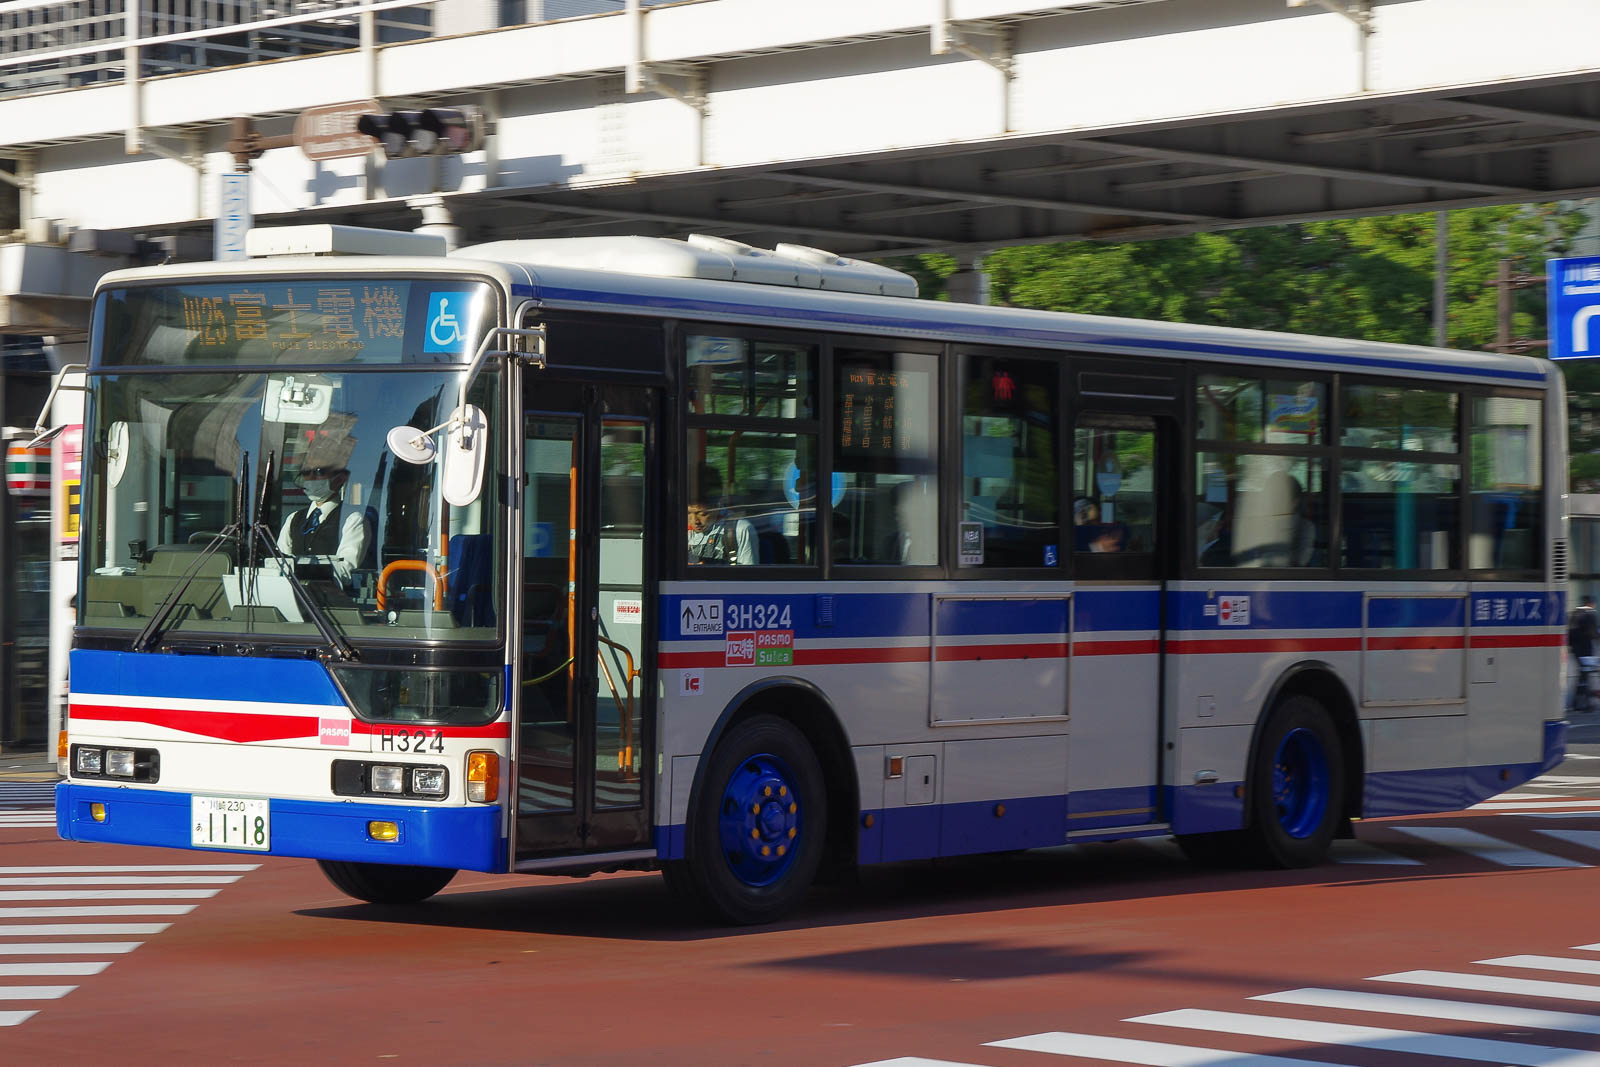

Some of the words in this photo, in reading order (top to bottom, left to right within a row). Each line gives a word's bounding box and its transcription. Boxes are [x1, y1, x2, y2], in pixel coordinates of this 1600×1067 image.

[272, 341, 301, 351] FUJI
[308, 340, 365, 351] ELECTRIC
[697, 604, 719, 620] 入口
[727, 604, 792, 630] 3H324
[693, 622, 722, 632] ENTRANCE
[758, 634, 791, 646] PASMO
[759, 650, 790, 663] Suica
[320, 727, 349, 737] PASMO
[380, 728, 445, 754] H324
[227, 801, 247, 813] 230
